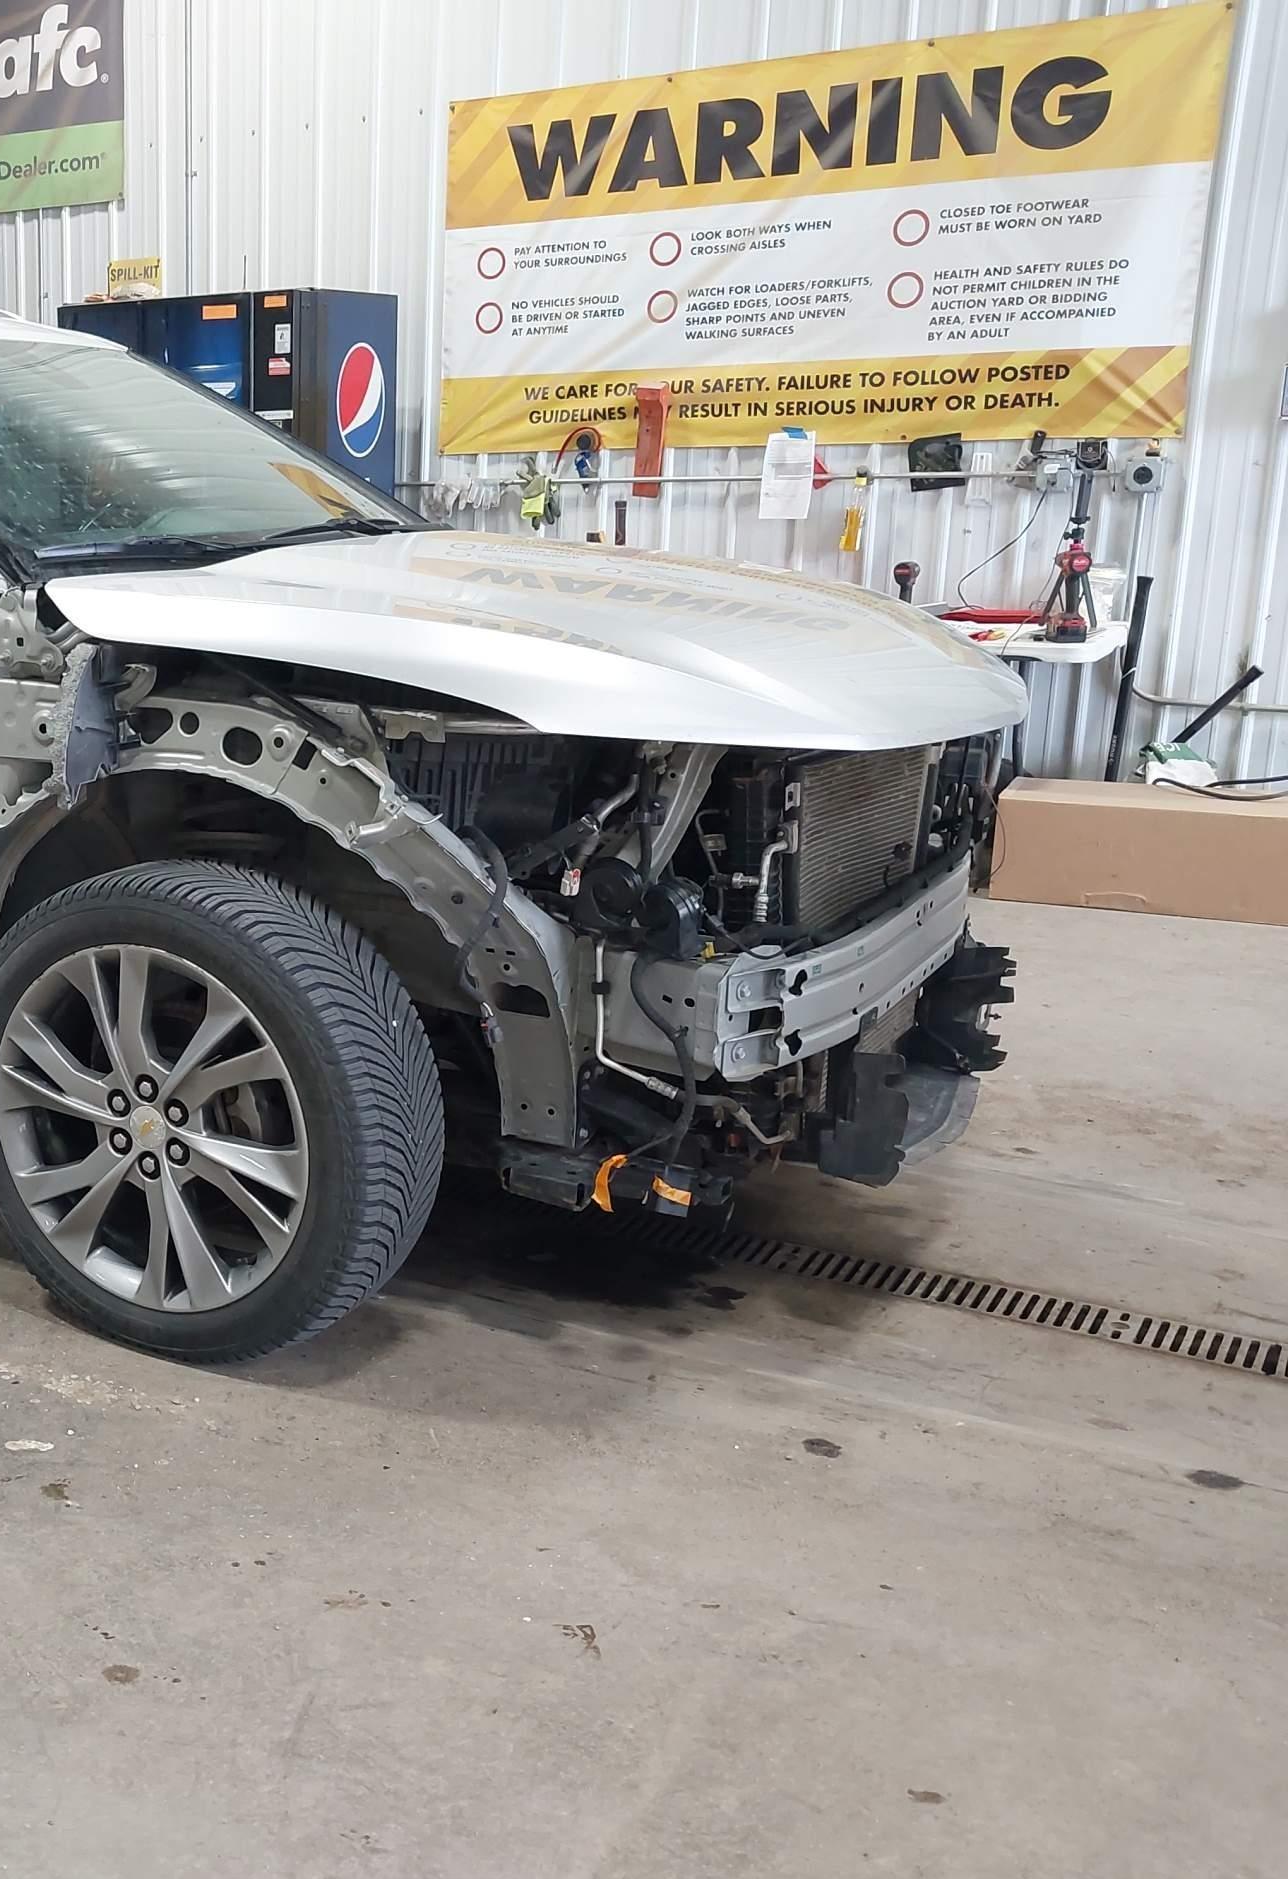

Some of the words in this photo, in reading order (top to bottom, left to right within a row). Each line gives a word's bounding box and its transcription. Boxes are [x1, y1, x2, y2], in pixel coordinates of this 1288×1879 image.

[507, 56, 1112, 201] WARNING
[940, 206, 985, 219] CLOSED
[990, 204, 1012, 214] TOE
[1017, 198, 1089, 212] FOOTWEAR
[691, 230, 722, 242] LOOK
[726, 227, 755, 239] BOTH
[758, 223, 791, 235] WAYS
[795, 220, 832, 232] WHEN
[938, 223, 972, 234] MUST
[976, 220, 991, 232] BE
[995, 217, 1037, 230] WORN
[1041, 215, 1063, 227] ON
[1067, 213, 1102, 225] YARD
[514, 246, 532, 256] PAY
[534, 241, 590, 254] ATTENTION
[593, 240, 607, 249] TO
[690, 242, 746, 256] CROSSING
[749, 238, 786, 250] AISLES
[514, 259, 541, 270] YOUR
[544, 252, 628, 268] SURROUNDINGS
[934, 268, 980, 281] HEALTH
[983, 265, 1012, 277] AND
[1016, 263, 1060, 275] SAFETY
[1065, 260, 1104, 272] RULES
[1108, 259, 1130, 270] DO
[110, 264, 159, 283] SPILL-KIT
[687, 287, 725, 299] WATCH
[728, 285, 752, 296] FOR
[932, 284, 959, 297] NOT
[962, 282, 1007, 294] PERMIT
[1010, 278, 1072, 291] CHILDREN
[1077, 276, 1092, 287] IN
[1096, 274, 1120, 286] THE
[511, 301, 529, 311] NO
[531, 297, 576, 309] VEHICLES
[577, 294, 620, 306] SHOULD
[685, 301, 730, 313] JAGGED
[733, 298, 772, 310] EDGES,
[775, 295, 812, 307] LOOSE
[815, 292, 853, 304] PARTS,
[930, 298, 987, 312] AUCTION
[991, 296, 1024, 308] YARD
[1028, 294, 1047, 305] OR
[1051, 291, 1108, 304] BIDDING
[511, 314, 523, 324] BE
[526, 311, 562, 323] DRIVEN
[564, 311, 580, 321] OR
[582, 308, 625, 320] STARTED
[685, 315, 723, 327] SHARP
[725, 312, 767, 325] POINTS
[769, 311, 795, 322] AND
[798, 307, 846, 320] UNEVEN
[929, 315, 965, 327] AREA,
[969, 312, 1002, 324] EVEN
[1005, 311, 1017, 322] IF
[1020, 307, 1117, 322] ACCOMPANIED
[511, 327, 523, 337] AT
[525, 324, 569, 337] ANYTIME
[685, 328, 738, 340] WALKING
[740, 325, 795, 338] SURFACES
[927, 331, 943, 341] BY
[947, 329, 967, 341] AN
[970, 327, 1010, 339] ADULT
[524, 386, 550, 401] WE
[554, 383, 599, 399] CARE
[604, 382, 639, 398] FOR
[700, 376, 771, 394] SAFETY.
[776, 373, 852, 391] FAILURE
[860, 371, 886, 388] TO
[891, 368, 980, 387] FOLLOW
[986, 364, 1071, 383] POSTED
[528, 405, 627, 425] GUIDELINES
[678, 402, 741, 419] RESULT
[747, 402, 769, 417] IN
[774, 399, 857, 417] SERIOUS
[863, 396, 939, 414] INJURY
[944, 394, 976, 411] OR
[983, 391, 1060, 410] DEATH.
